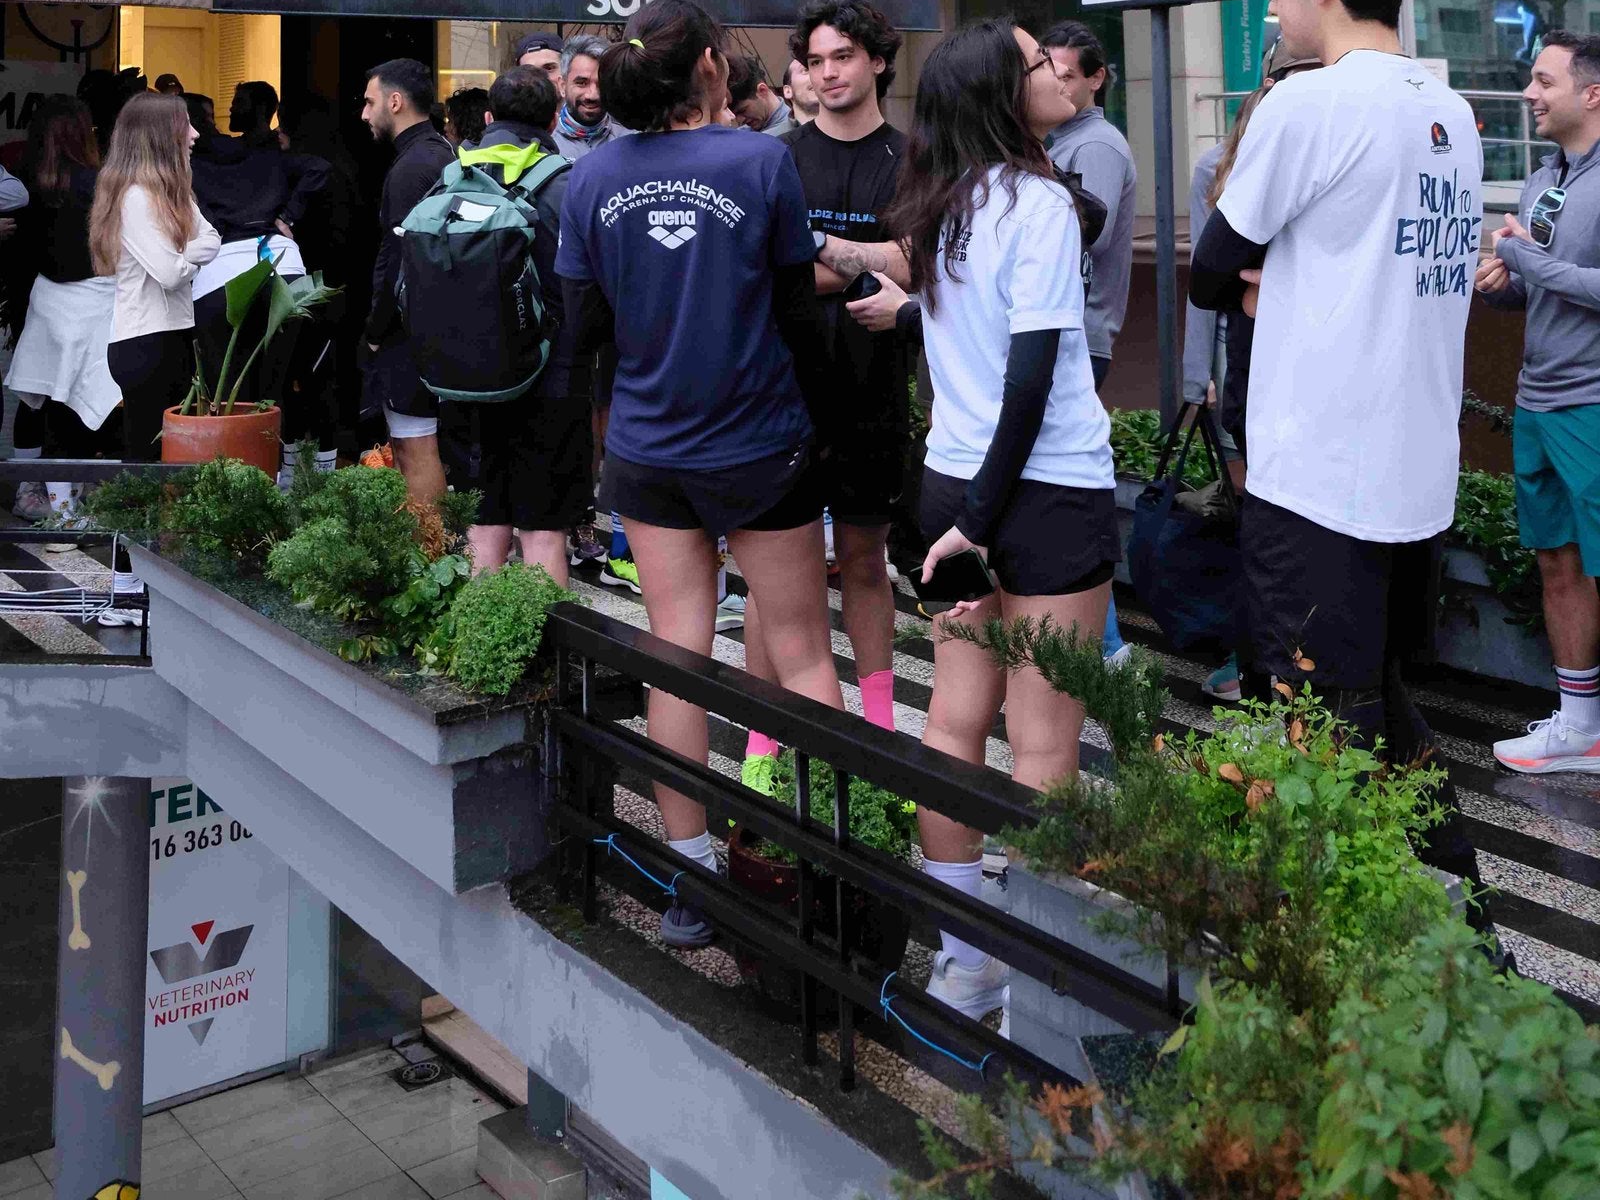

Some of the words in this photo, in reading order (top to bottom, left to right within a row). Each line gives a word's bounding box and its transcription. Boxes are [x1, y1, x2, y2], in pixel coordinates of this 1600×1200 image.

[599, 178, 746, 223] AQUACHALLENGE
[605, 211, 620, 229] THE
[622, 196, 657, 214] ARENA
[680, 196, 736, 229] CHAMPIONS
[1418, 168, 1458, 219] RUN
[1458, 189, 1472, 215] TO
[648, 210, 696, 226] arena
[1394, 216, 1482, 261] EXPLORE
[184, 824, 223, 853] 363
[148, 968, 256, 1010] VETERINARY
[154, 987, 250, 1028] NUTRITION
